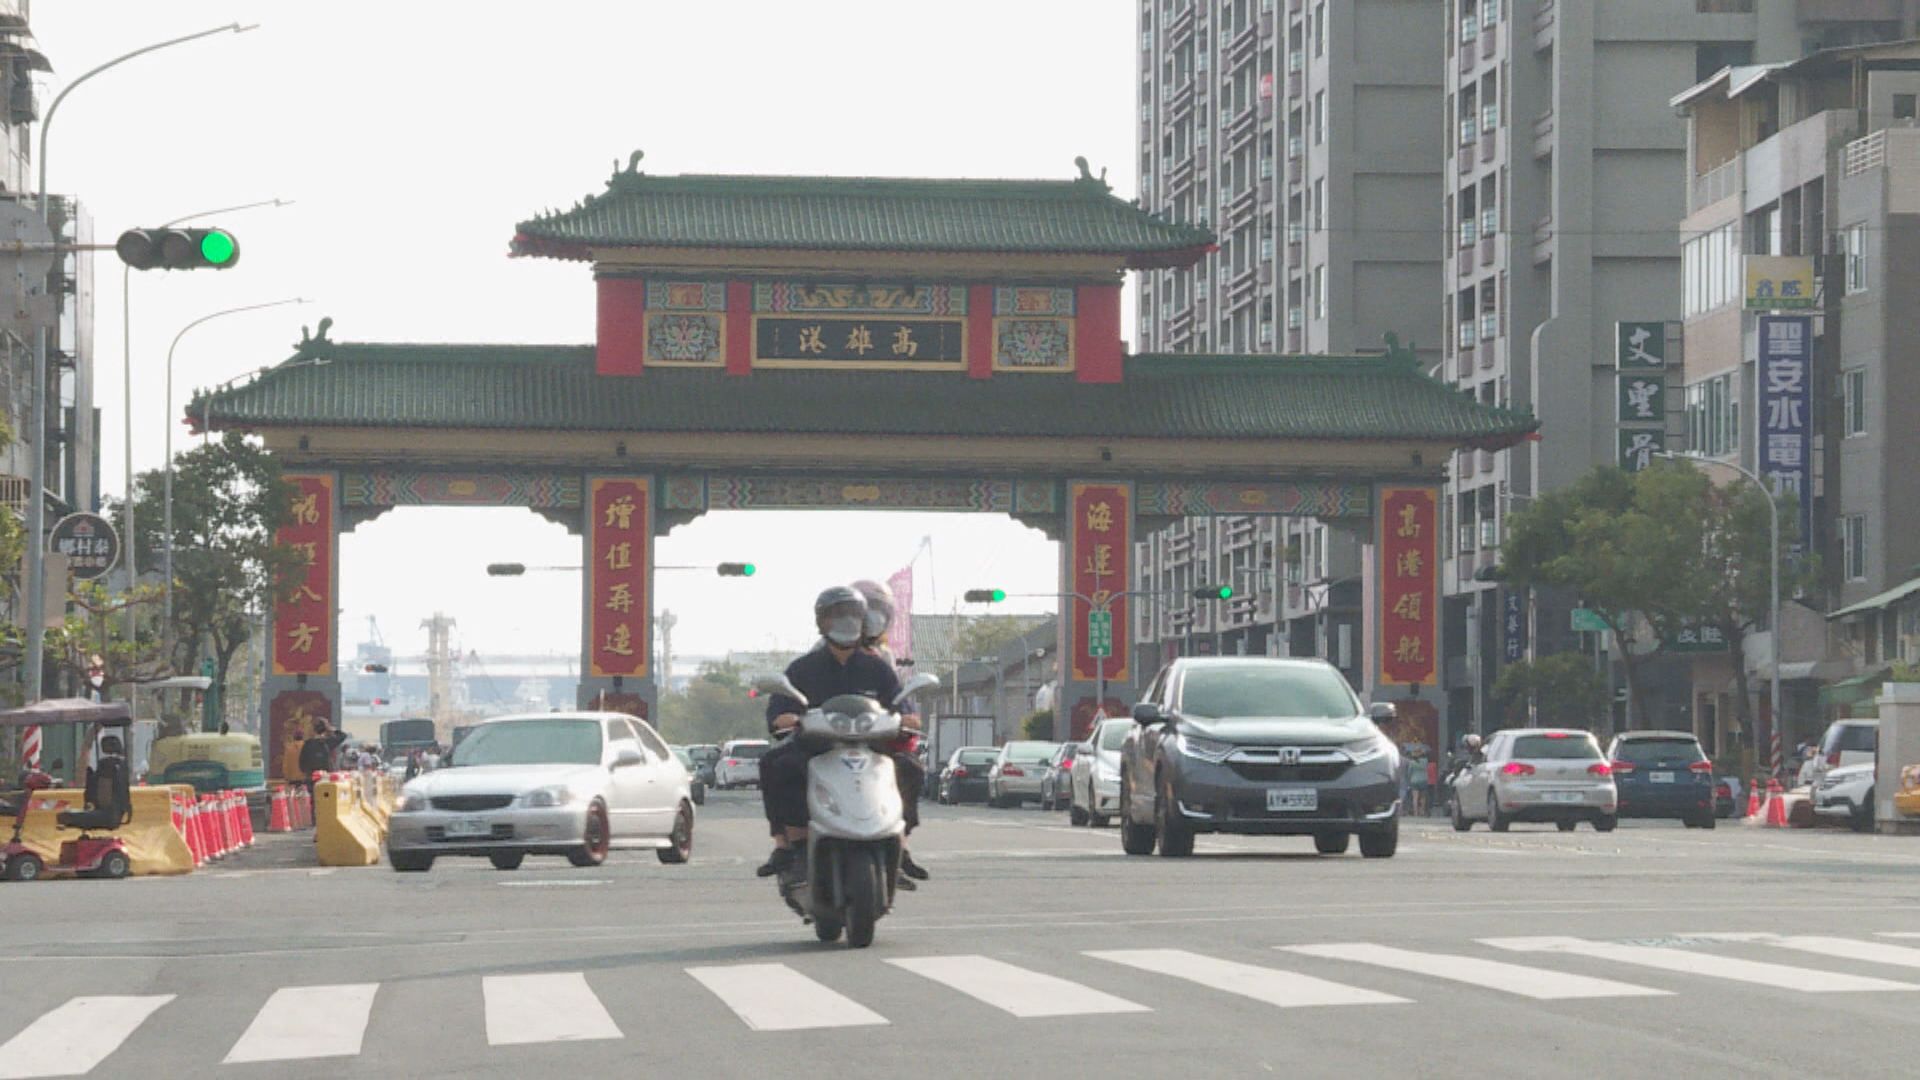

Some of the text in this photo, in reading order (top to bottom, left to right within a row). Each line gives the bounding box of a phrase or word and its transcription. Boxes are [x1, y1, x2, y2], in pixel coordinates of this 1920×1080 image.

[603, 495, 637, 656] 增值再造
[1392, 503, 1425, 664] 高港領航
